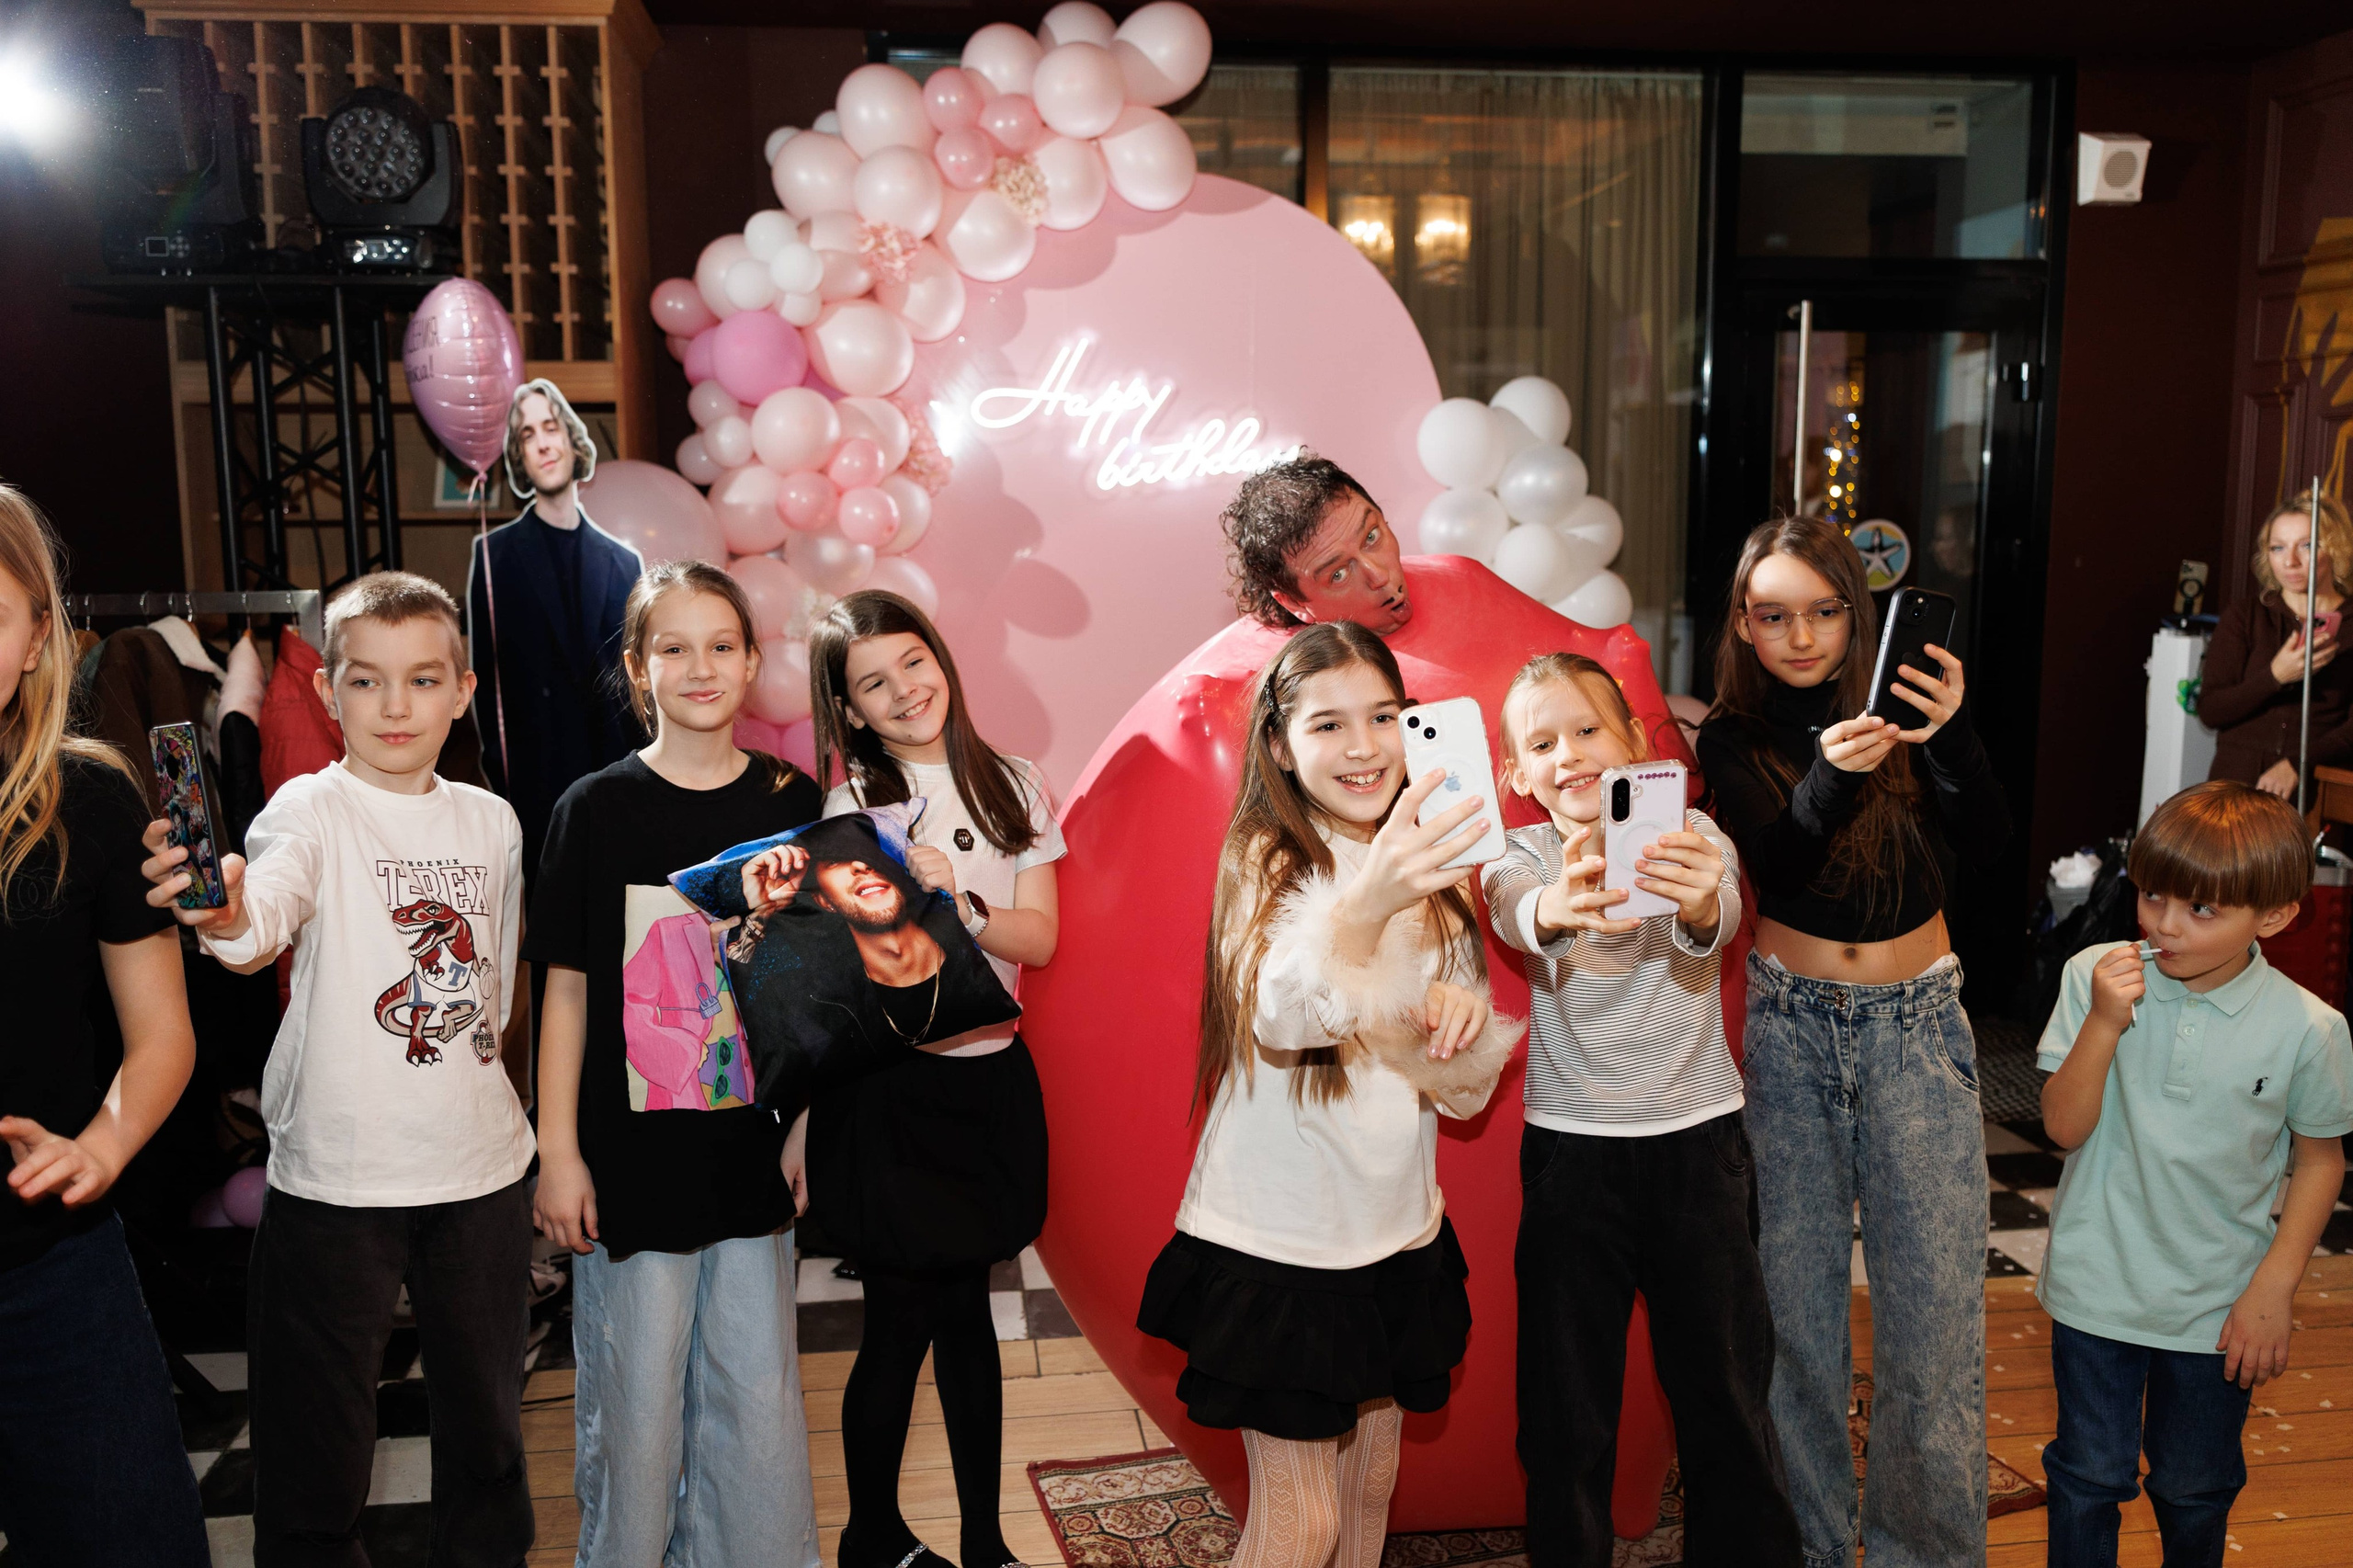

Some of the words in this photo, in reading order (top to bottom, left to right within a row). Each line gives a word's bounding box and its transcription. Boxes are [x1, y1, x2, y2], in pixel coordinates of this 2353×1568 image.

[971, 337, 1172, 449] Happy
[400, 858, 460, 868] PHOENIX
[376, 859, 490, 916] T-REX
[448, 961, 467, 986] T
